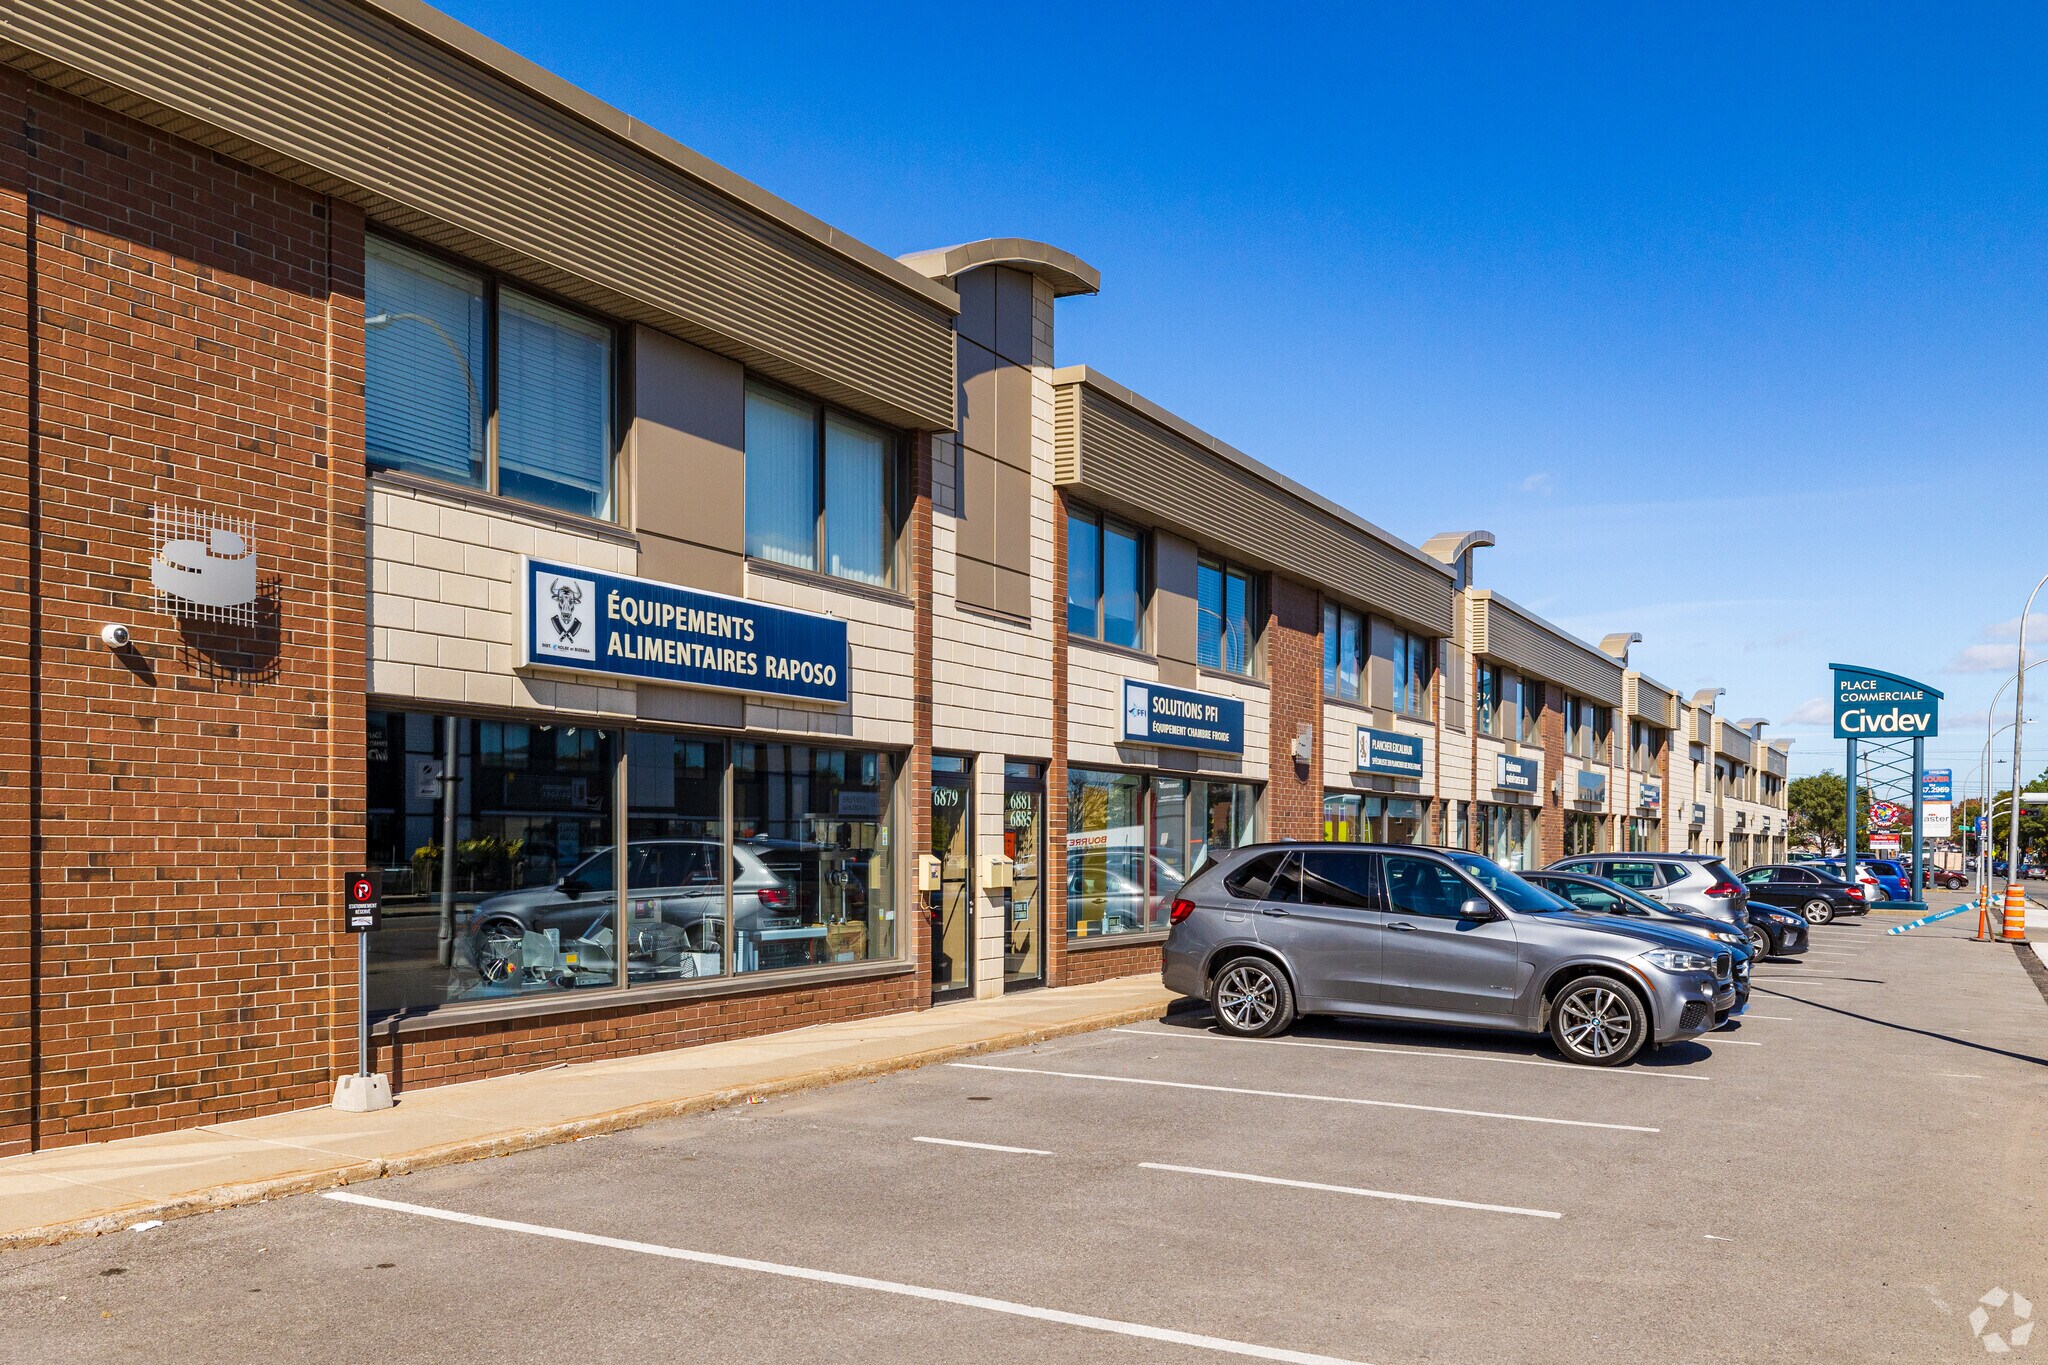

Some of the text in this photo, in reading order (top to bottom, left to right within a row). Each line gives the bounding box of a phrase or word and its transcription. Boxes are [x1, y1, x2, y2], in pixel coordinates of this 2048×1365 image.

[607, 590, 755, 642] ÉQUIPEMENTS
[607, 631, 837, 687] ALIMENTAIRES RAPOSO
[1840, 680, 1877, 690] PLACE
[1840, 691, 1923, 702] COMMERCIALE
[1137, 709, 1146, 717] PFI
[1152, 696, 1218, 722] SOLUTIONS PFI
[1840, 707, 1931, 732] Civdev
[1152, 720, 1230, 742] ÉQUIPEMENT CHAMBRE FROIDE
[934, 788, 958, 806] 6879
[1010, 793, 1032, 810] 6881
[1010, 810, 1032, 826] 6885
